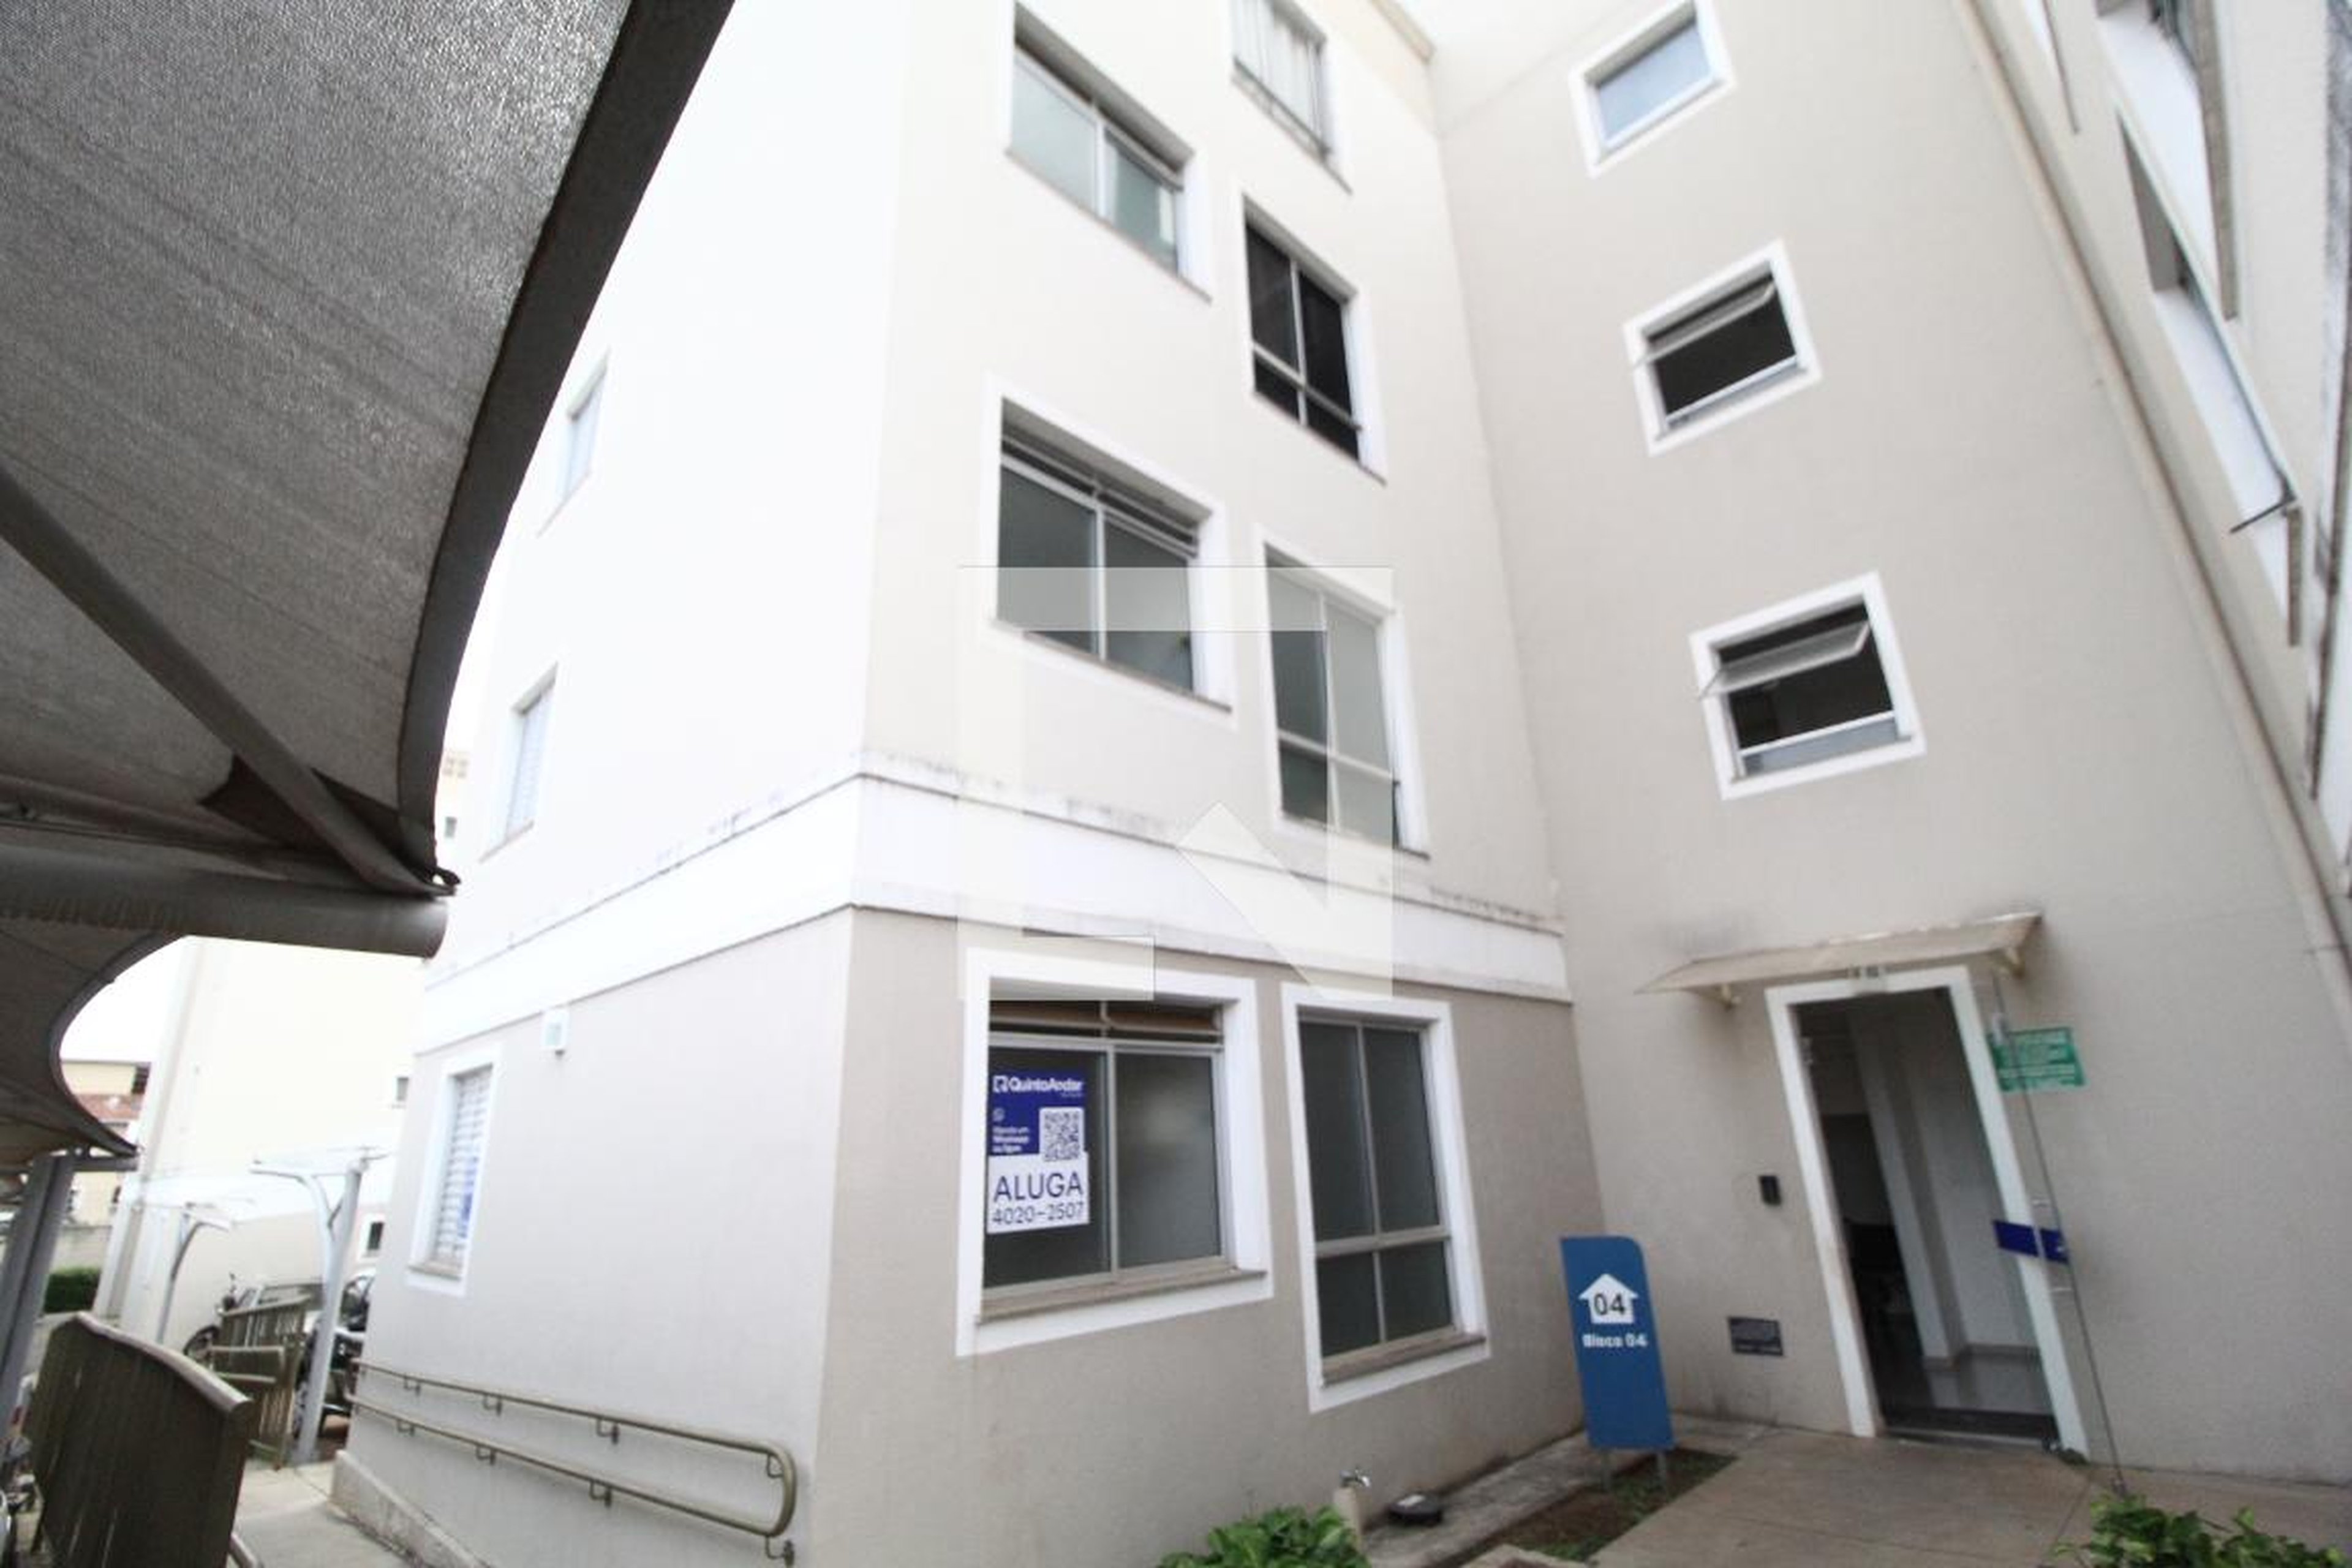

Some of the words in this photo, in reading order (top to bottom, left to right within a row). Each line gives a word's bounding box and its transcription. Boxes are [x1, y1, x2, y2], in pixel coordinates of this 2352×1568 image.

[1009, 1076, 1083, 1093] QuintoAndar
[993, 1170, 1084, 1203] ALUGA
[992, 1200, 1084, 1225] 4020-2507
[1593, 1293, 1626, 1316] 04
[1581, 1333, 1623, 1348] Bloco
[1625, 1333, 1648, 1348] 04
